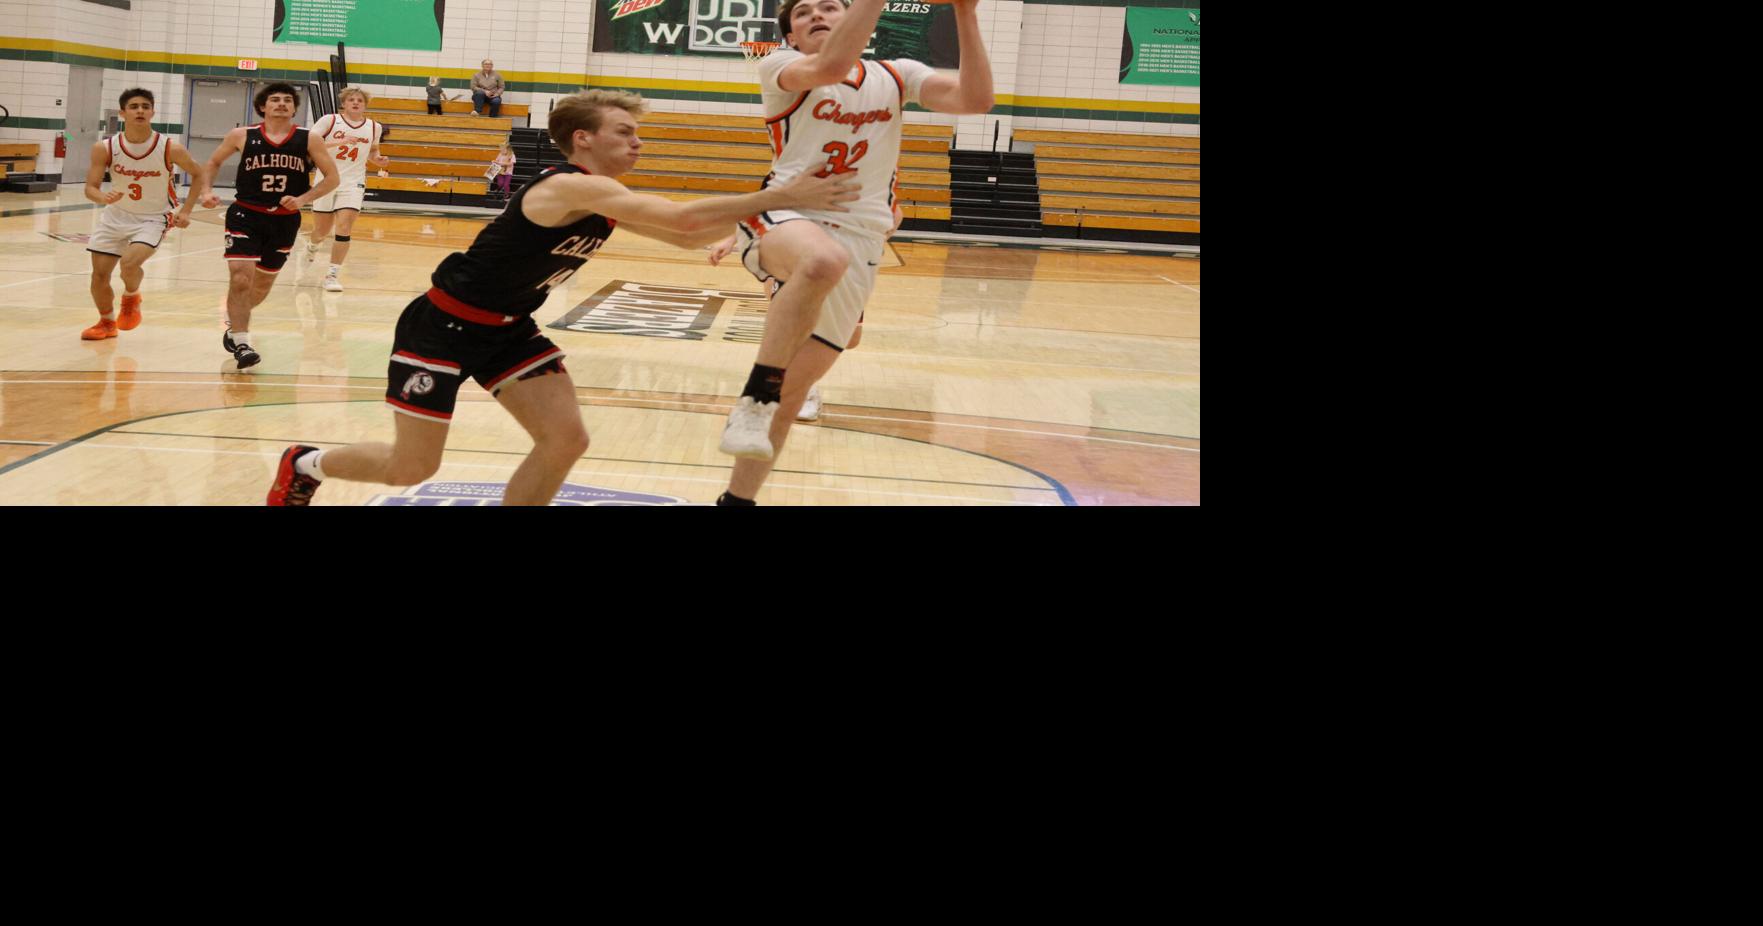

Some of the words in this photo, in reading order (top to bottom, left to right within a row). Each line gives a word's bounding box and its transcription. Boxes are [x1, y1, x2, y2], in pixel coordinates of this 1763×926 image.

[881, 2, 931, 14] AZERS
[241, 60, 255, 70] EXIT
[336, 145, 359, 162] 24
[814, 140, 868, 179] 32
[114, 163, 161, 181] Chargers
[245, 153, 305, 173] CALHOUN
[128, 183, 142, 201] 3
[262, 174, 288, 193] 23
